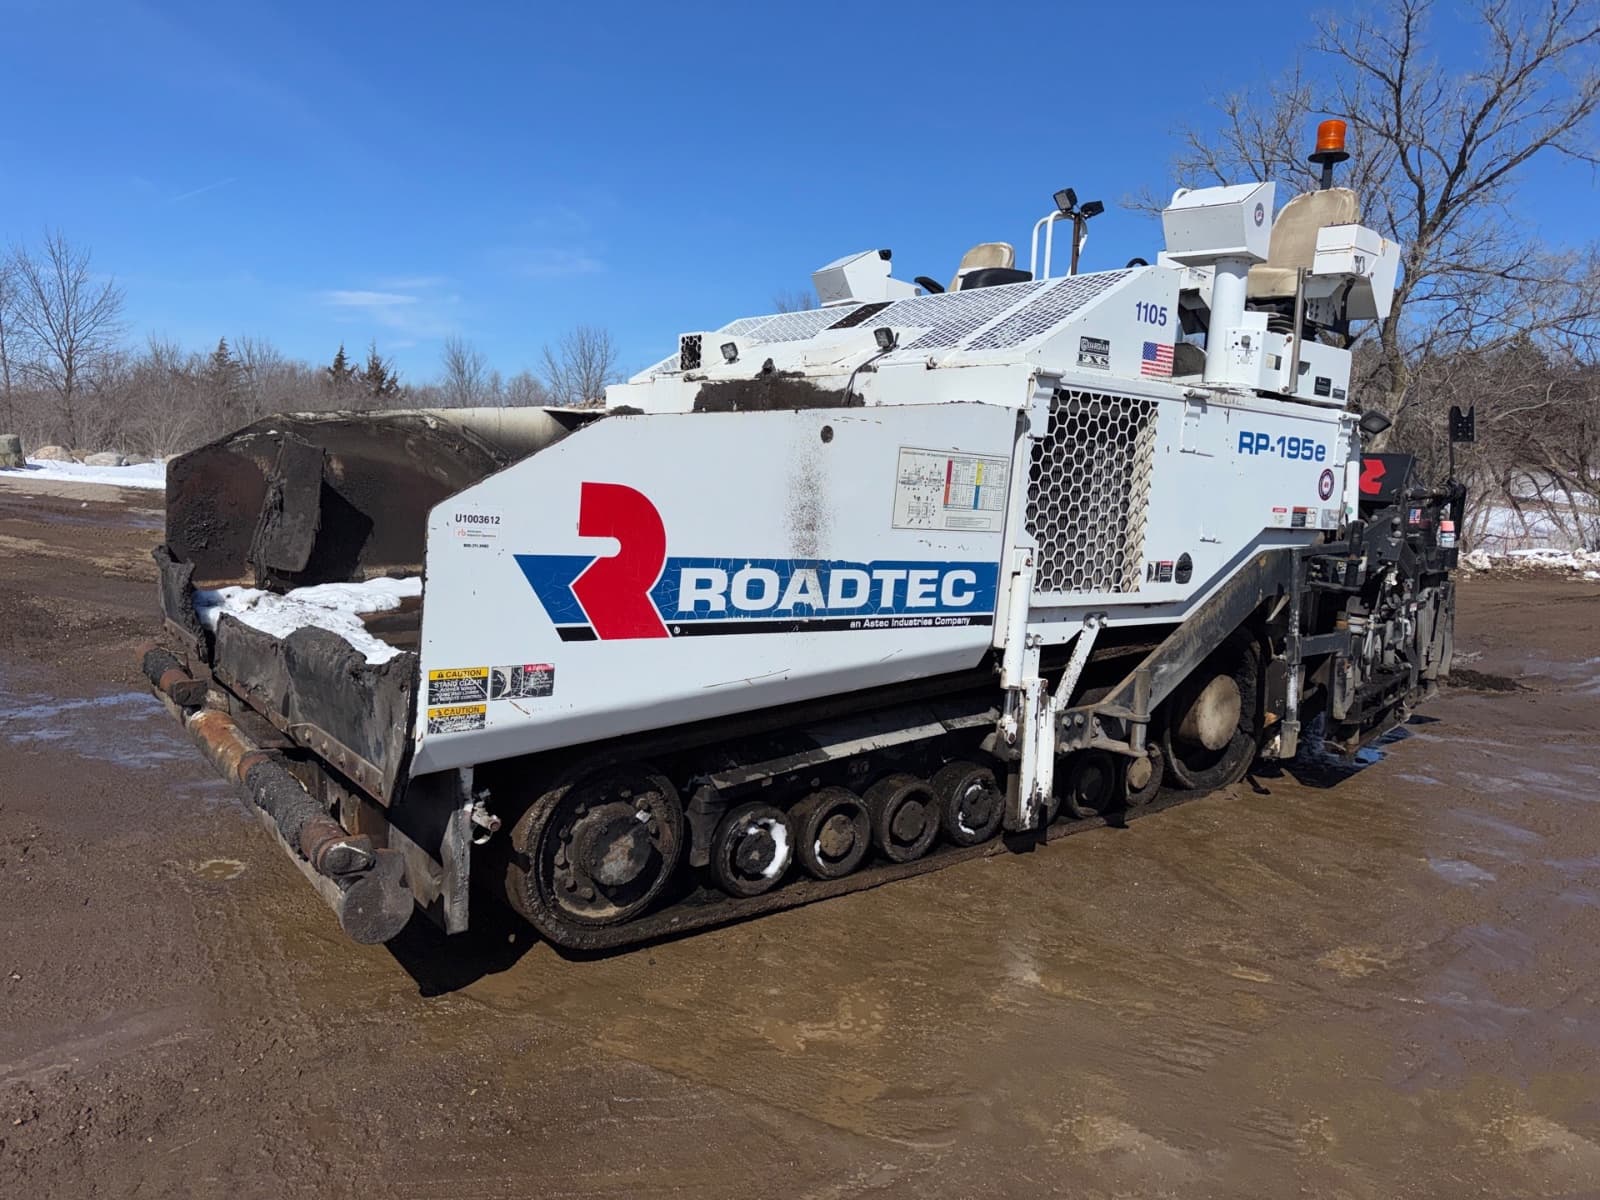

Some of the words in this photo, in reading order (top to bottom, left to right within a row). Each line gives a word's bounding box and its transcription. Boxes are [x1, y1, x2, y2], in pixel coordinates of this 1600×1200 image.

[1136, 301, 1167, 326] 1105
[1238, 430, 1326, 462] RP-195e
[455, 513, 501, 525] U1003612
[678, 566, 977, 612] ROADTEC
[849, 620, 861, 629] an
[863, 618, 889, 628] Astec
[891, 617, 932, 627] Industries
[935, 616, 971, 626] Company
[445, 669, 482, 678] CAUTION
[434, 680, 458, 689] STAND
[443, 706, 480, 716] CAUTION
